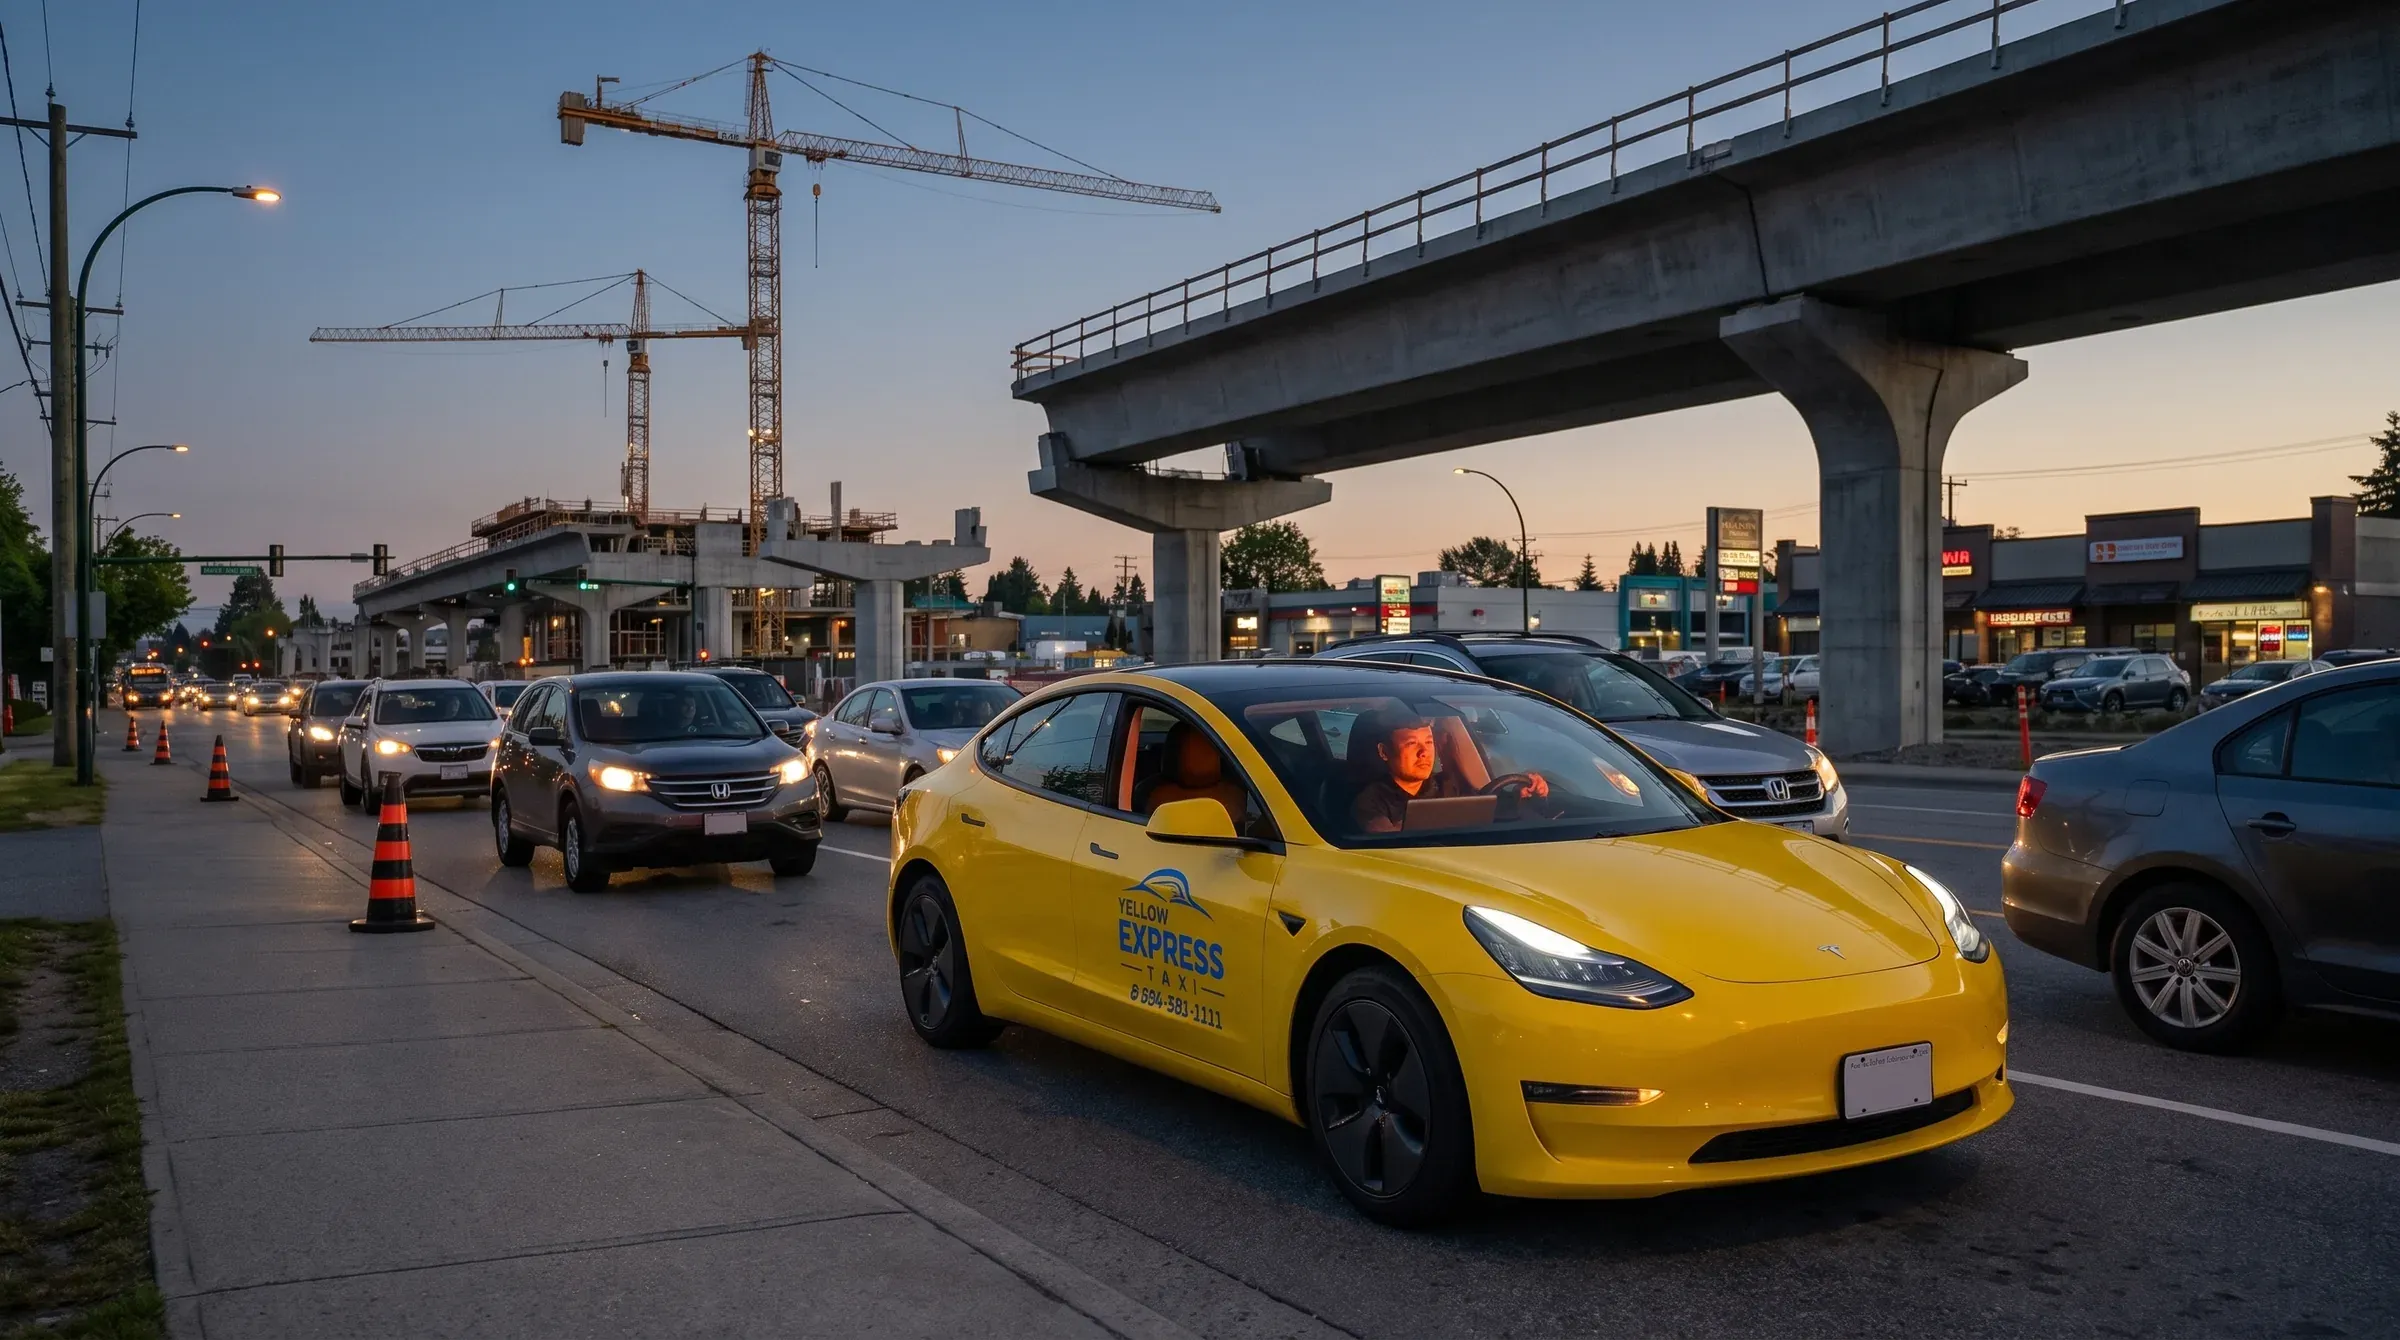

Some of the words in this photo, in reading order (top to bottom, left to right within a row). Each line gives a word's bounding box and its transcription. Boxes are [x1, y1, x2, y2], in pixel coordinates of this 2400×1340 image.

[1118, 897, 1169, 925] YELLOW
[1118, 918, 1225, 980] EXPRESS
[1147, 965, 1197, 995] TAXI
